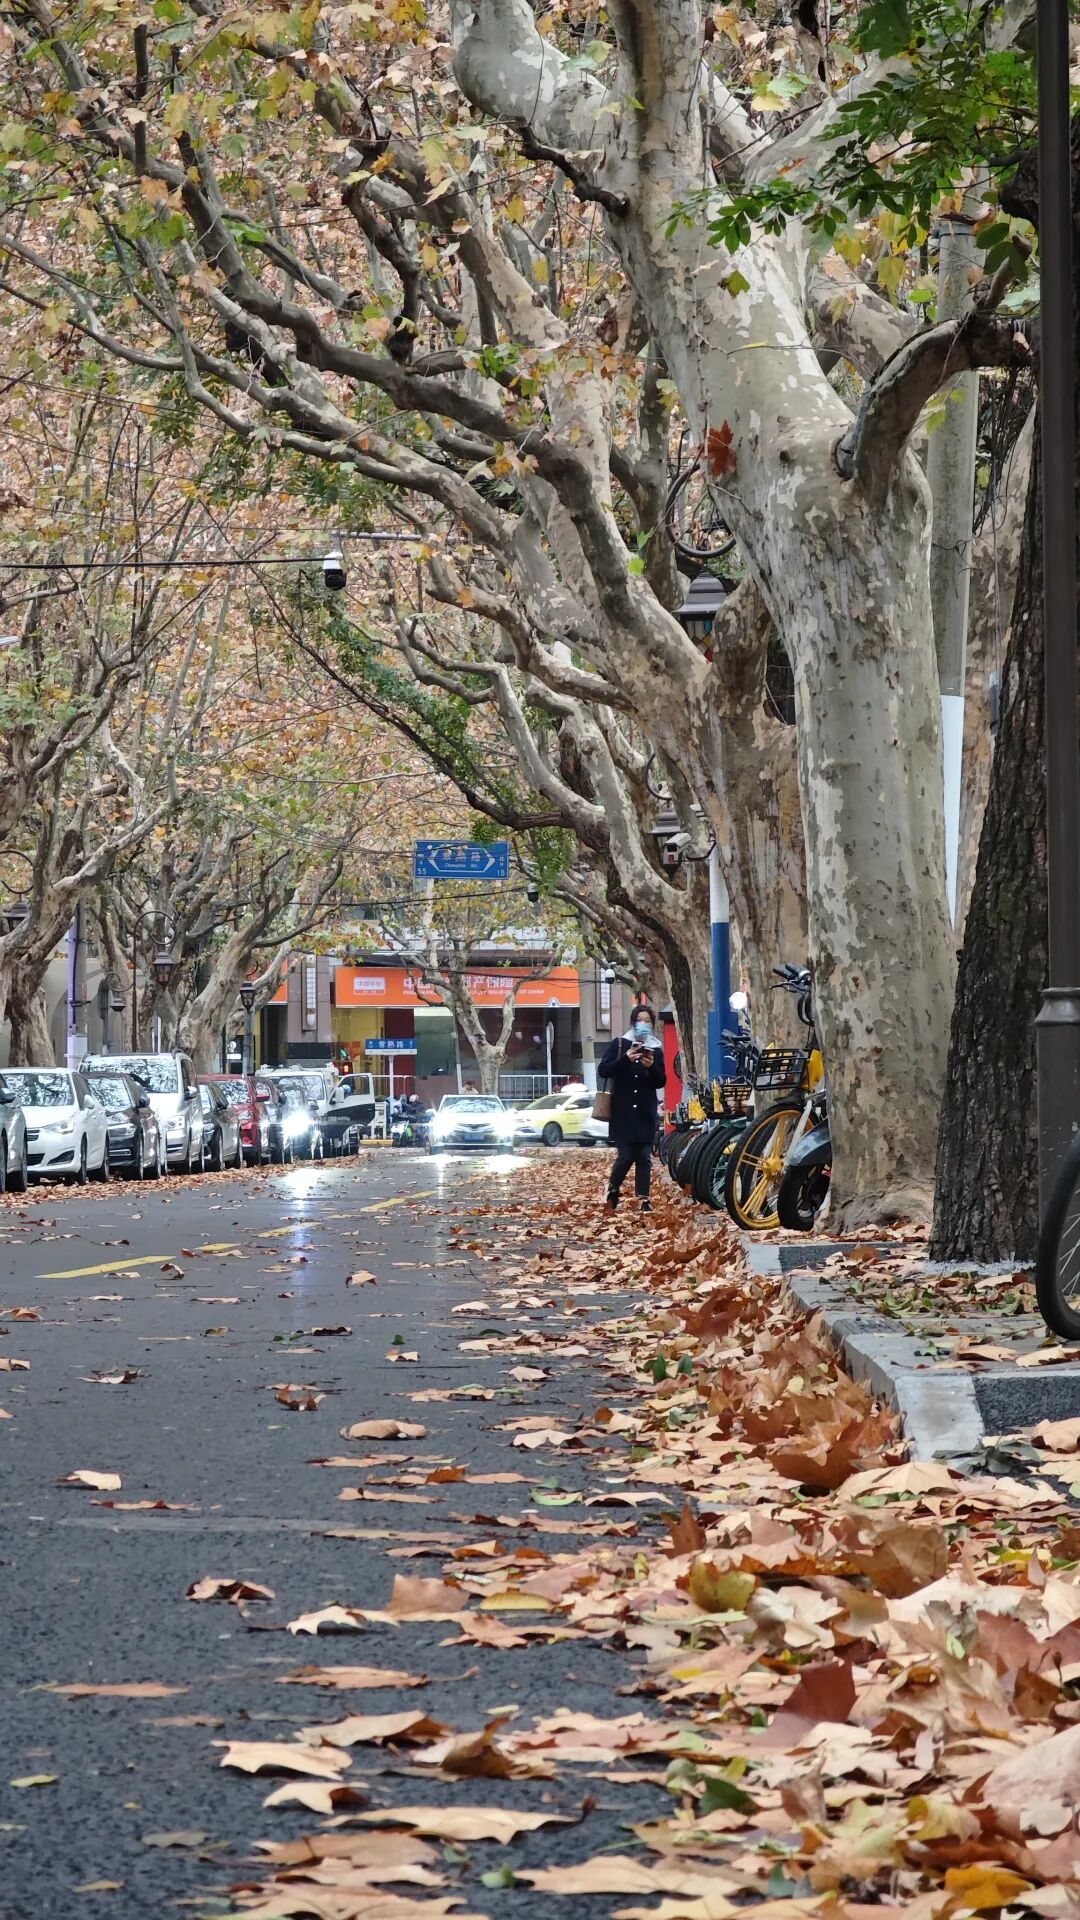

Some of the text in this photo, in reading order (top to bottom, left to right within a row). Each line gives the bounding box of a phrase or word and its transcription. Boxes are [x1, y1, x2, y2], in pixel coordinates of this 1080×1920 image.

[417, 867, 427, 875] 55
[403, 976, 513, 989] 中国产保险
